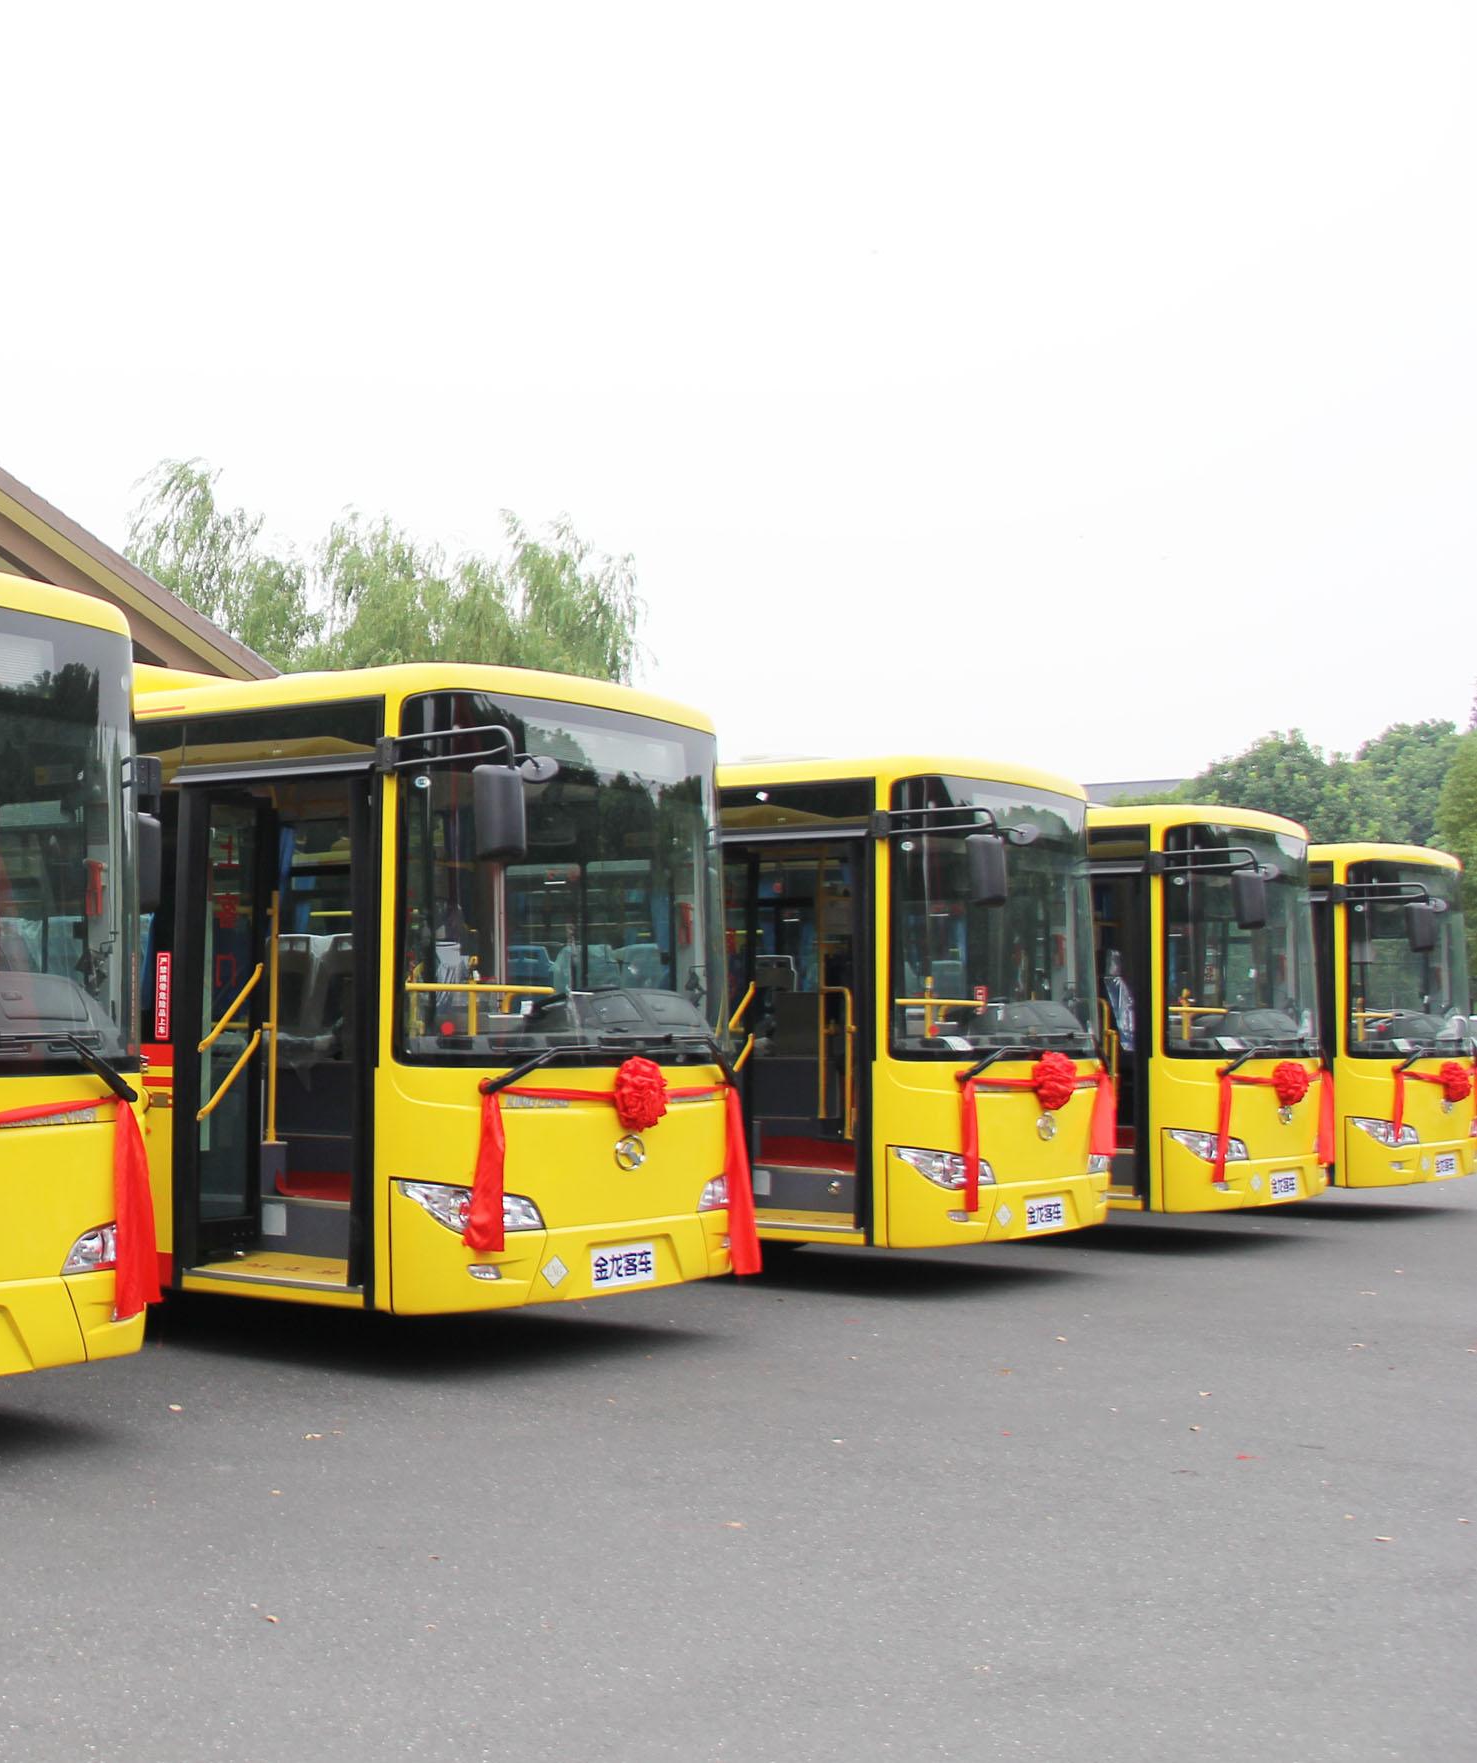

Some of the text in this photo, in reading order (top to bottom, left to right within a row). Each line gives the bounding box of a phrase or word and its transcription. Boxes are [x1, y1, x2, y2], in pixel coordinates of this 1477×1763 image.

[1027, 1203, 1062, 1225] 金龙客车
[593, 1250, 652, 1281] 金龙客车
